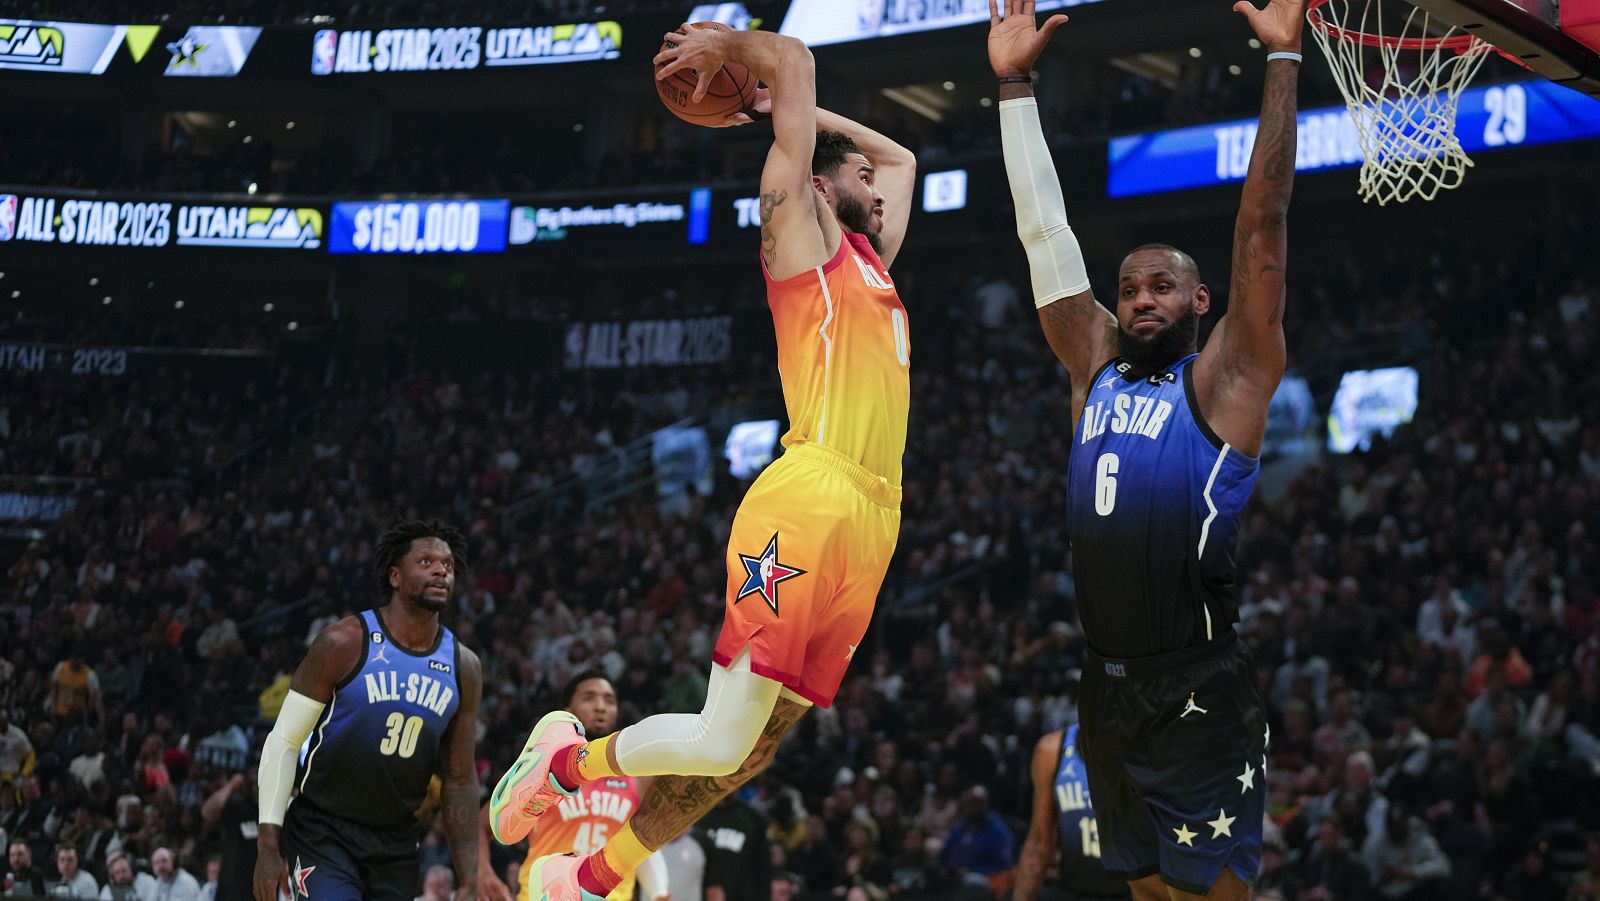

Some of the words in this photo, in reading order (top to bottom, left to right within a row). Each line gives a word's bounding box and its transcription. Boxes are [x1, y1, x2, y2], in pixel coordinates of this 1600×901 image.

[1484, 84, 1527, 146] 29
[1214, 122, 1259, 179] TEA
[352, 202, 480, 254] $150,000
[1116, 362, 1131, 373] 6
[1094, 452, 1120, 517] 6
[379, 711, 424, 759] 30
[572, 821, 610, 858] 45
